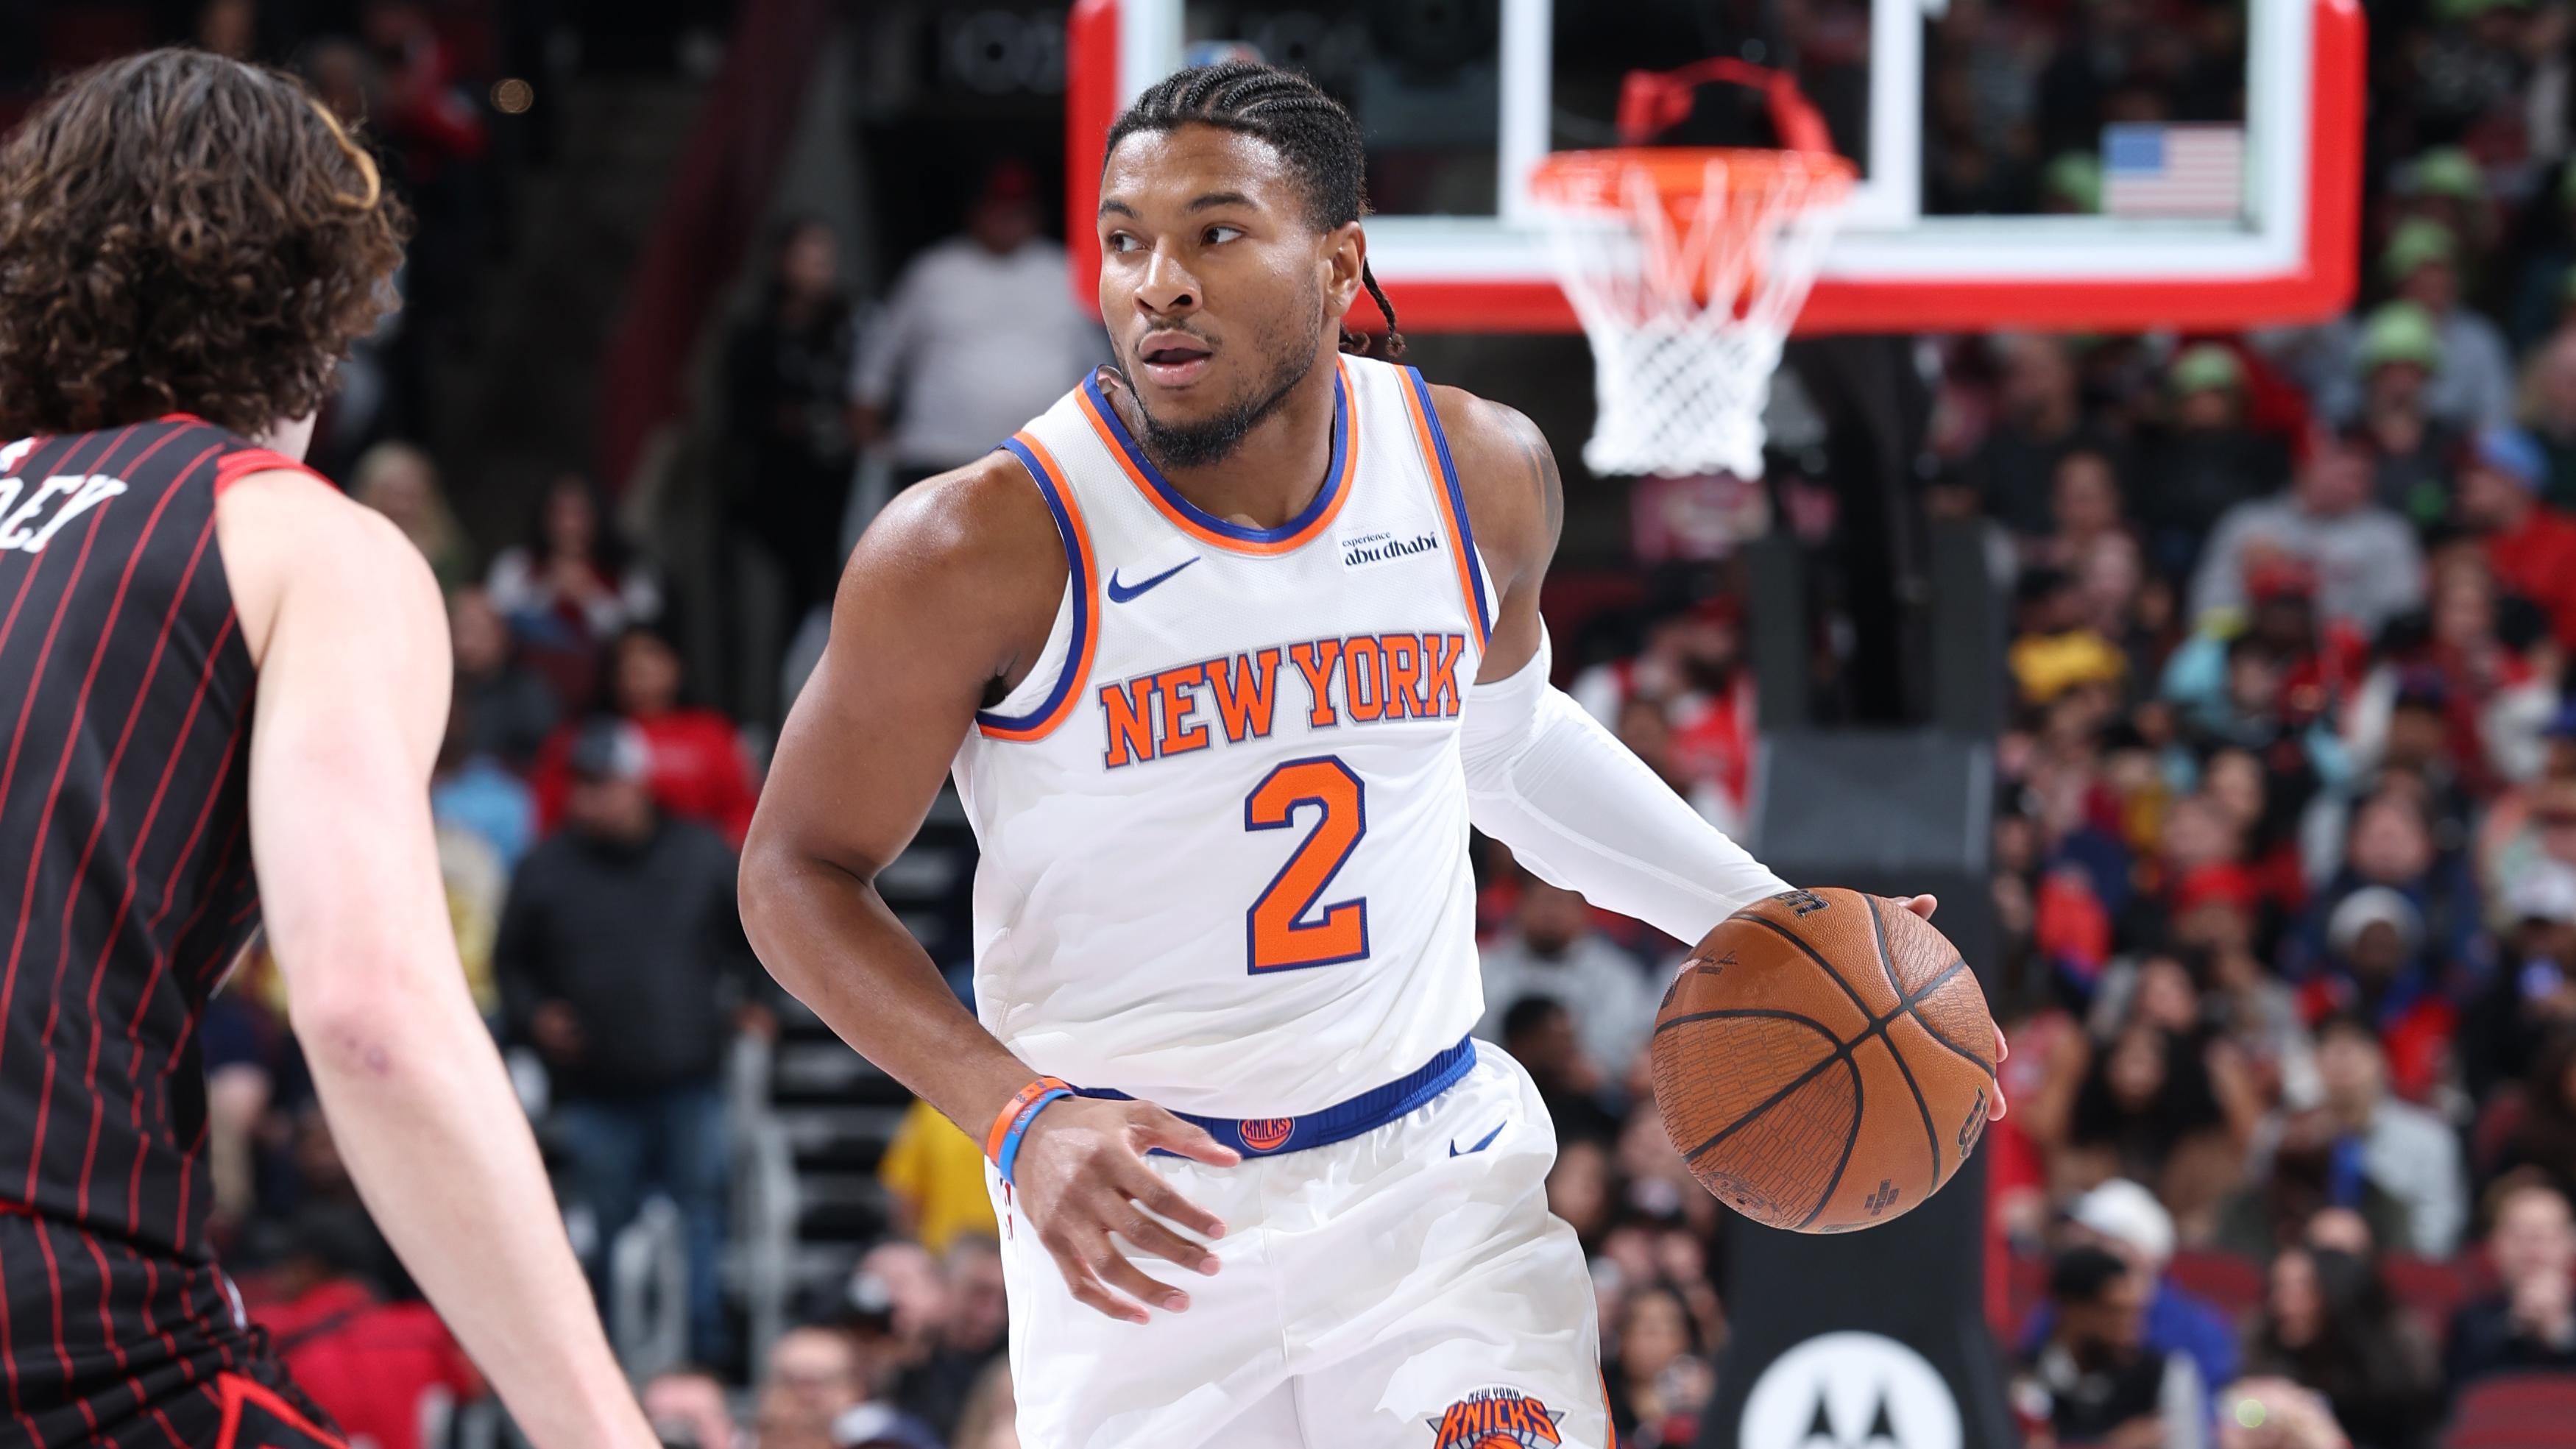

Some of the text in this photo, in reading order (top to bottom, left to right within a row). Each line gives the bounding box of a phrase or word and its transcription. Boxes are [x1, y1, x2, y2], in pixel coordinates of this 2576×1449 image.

[1342, 531, 1391, 547] experience
[1345, 531, 1439, 566] abu dhabi
[1097, 631, 1465, 770] NEW YORK
[1245, 754, 1370, 975] 2
[1245, 1119, 1287, 1138] KNICKS
[1468, 1387, 1521, 1404] NEW YORK
[1433, 1395, 1562, 1449] KNICKS
